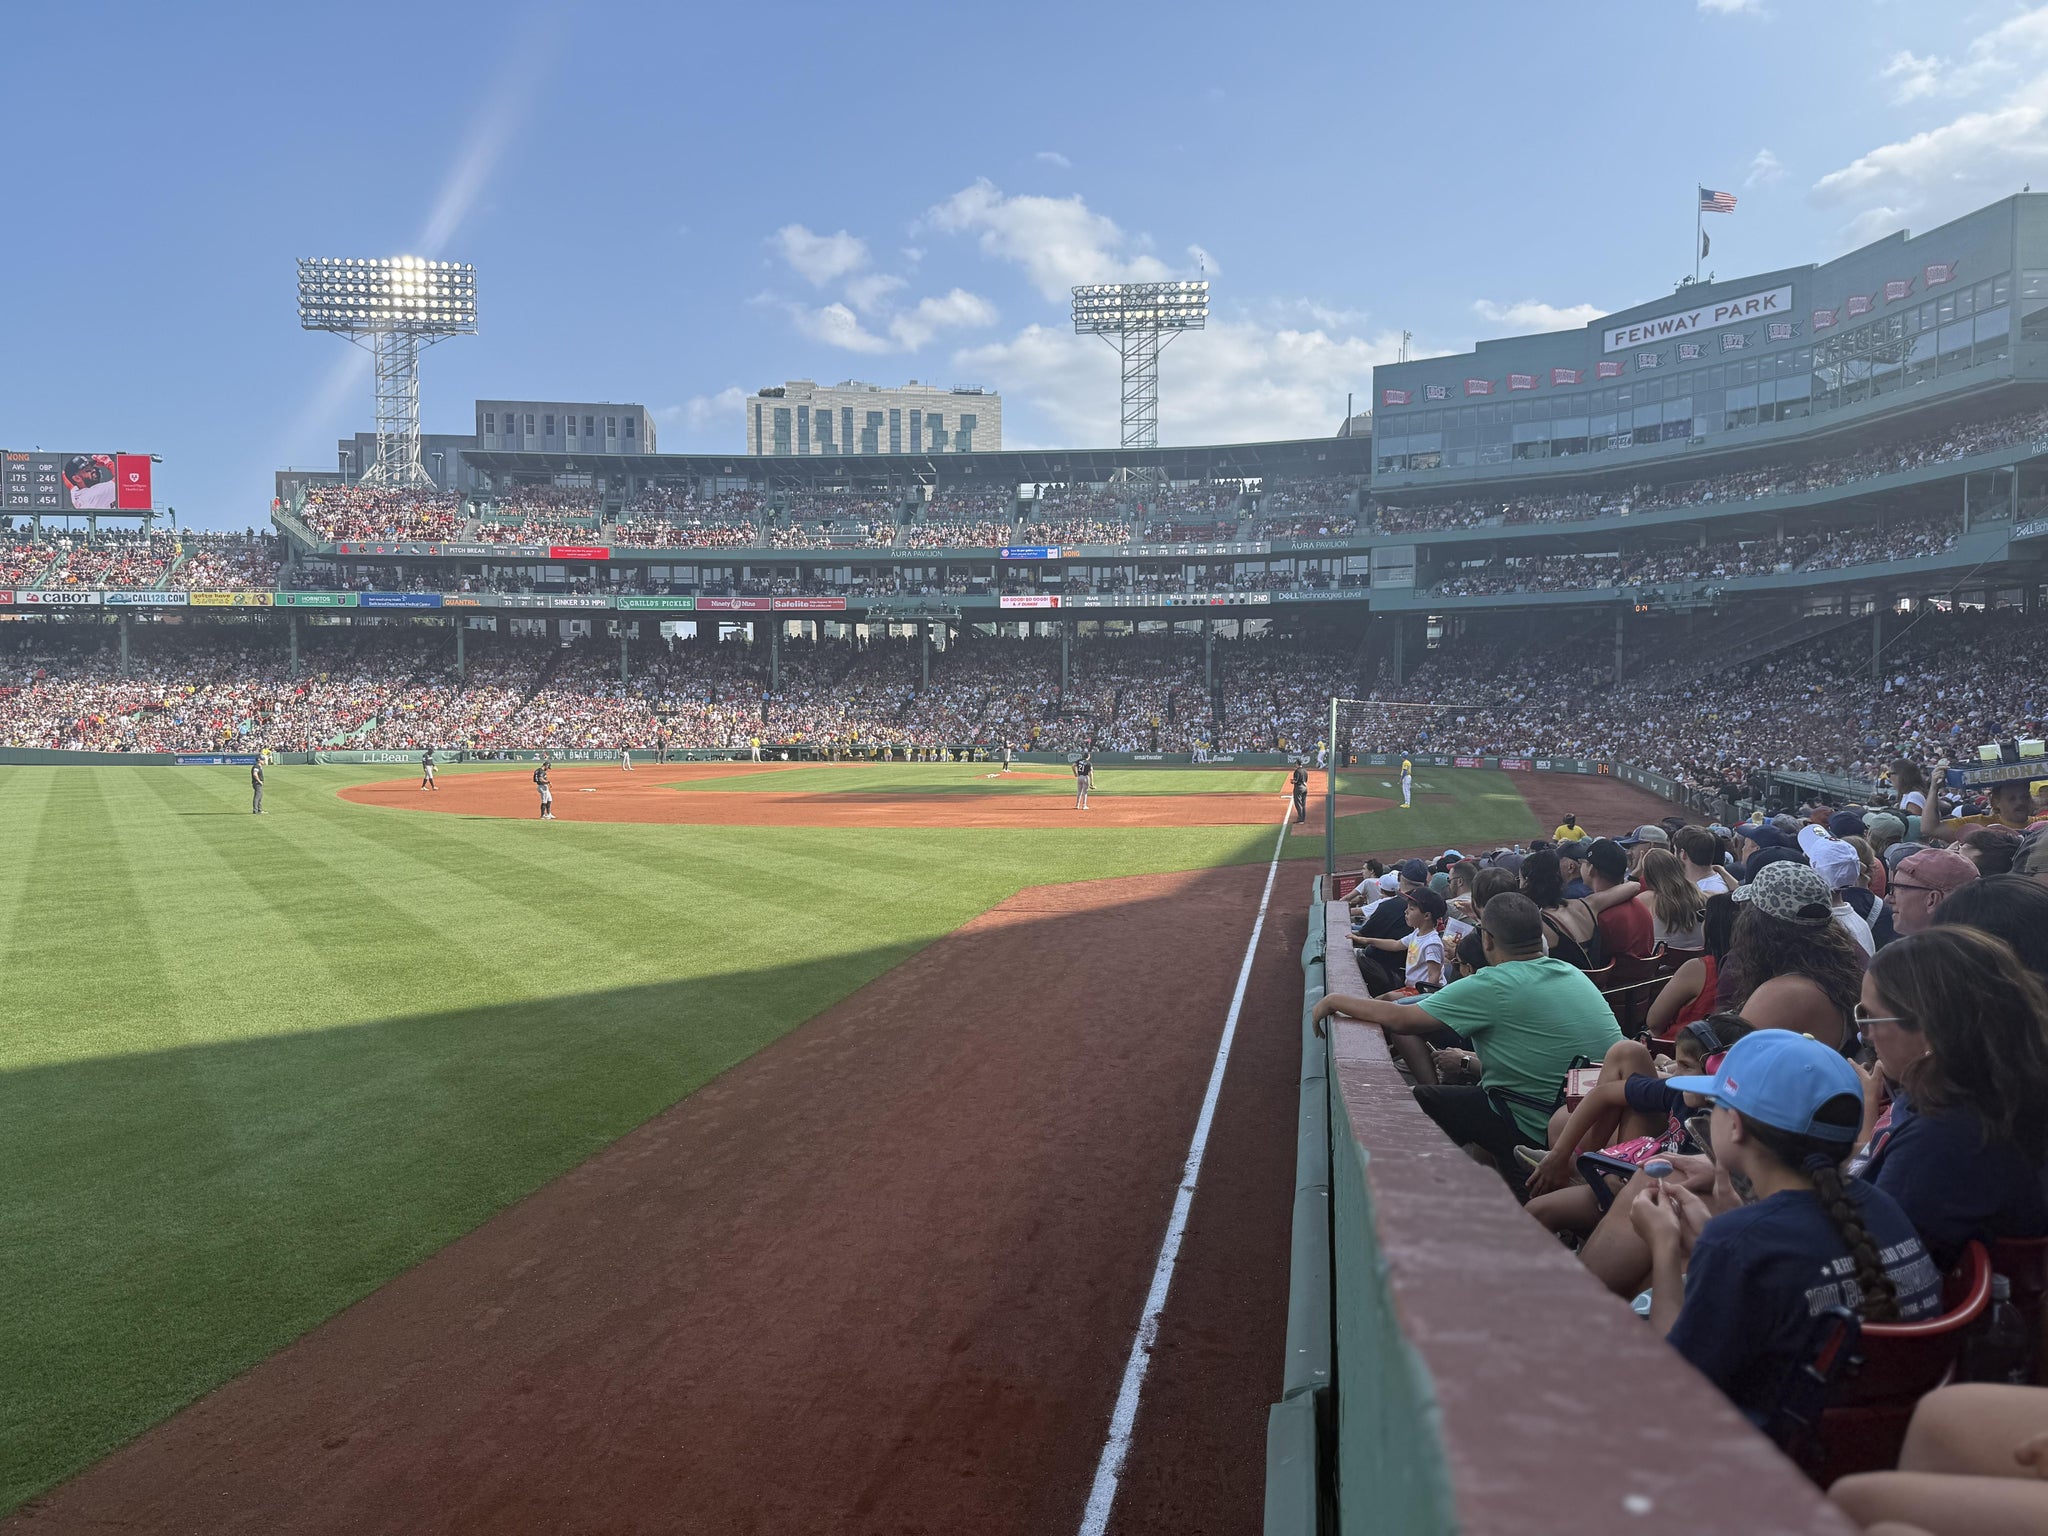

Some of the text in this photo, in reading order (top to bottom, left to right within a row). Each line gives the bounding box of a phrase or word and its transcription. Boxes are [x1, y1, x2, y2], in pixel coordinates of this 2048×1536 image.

[1615, 294, 1777, 346] FENWAY PARK
[1315, 541, 1349, 549] PAVILION
[132, 594, 185, 603] CALL128.COM
[1279, 590, 1362, 600] DELL Technologies Level
[362, 753, 409, 762] L.L.Bean
[1969, 761, 2048, 784] LEMONA
